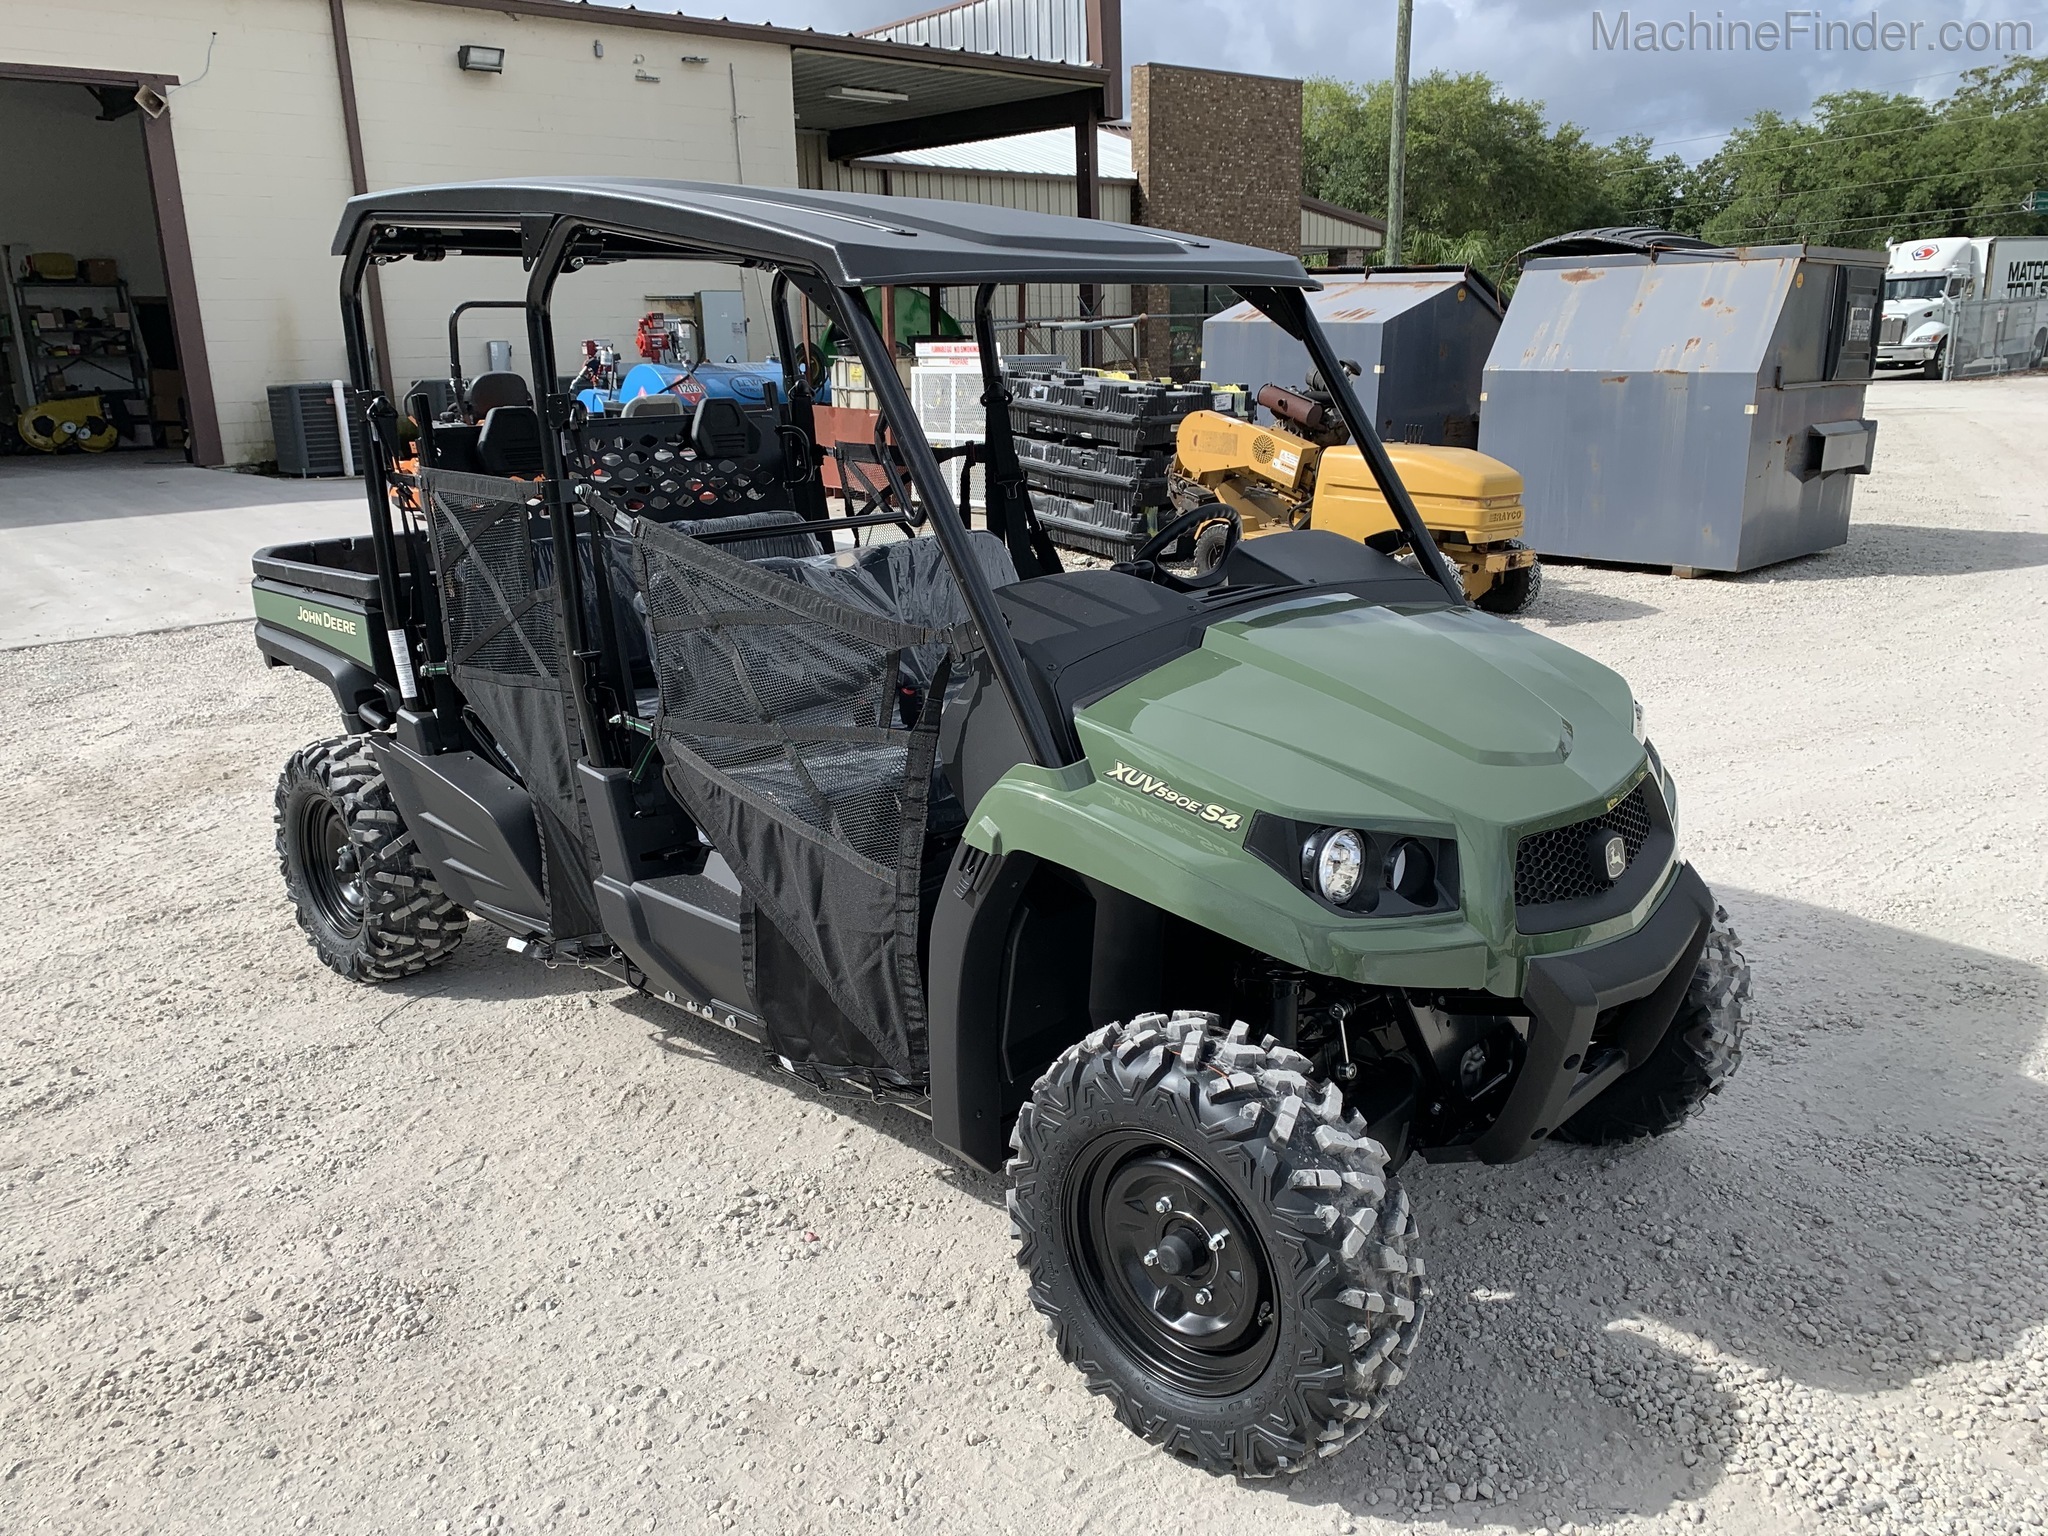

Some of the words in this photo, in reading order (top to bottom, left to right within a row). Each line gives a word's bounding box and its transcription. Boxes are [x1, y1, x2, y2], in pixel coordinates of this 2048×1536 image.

[680, 383, 700, 393] 1203
[1495, 510, 1522, 522] RAYCO
[297, 605, 323, 627] JOHN
[323, 611, 357, 636] DEERE
[1103, 759, 1204, 815] XUV590E
[1200, 803, 1243, 832] S4
